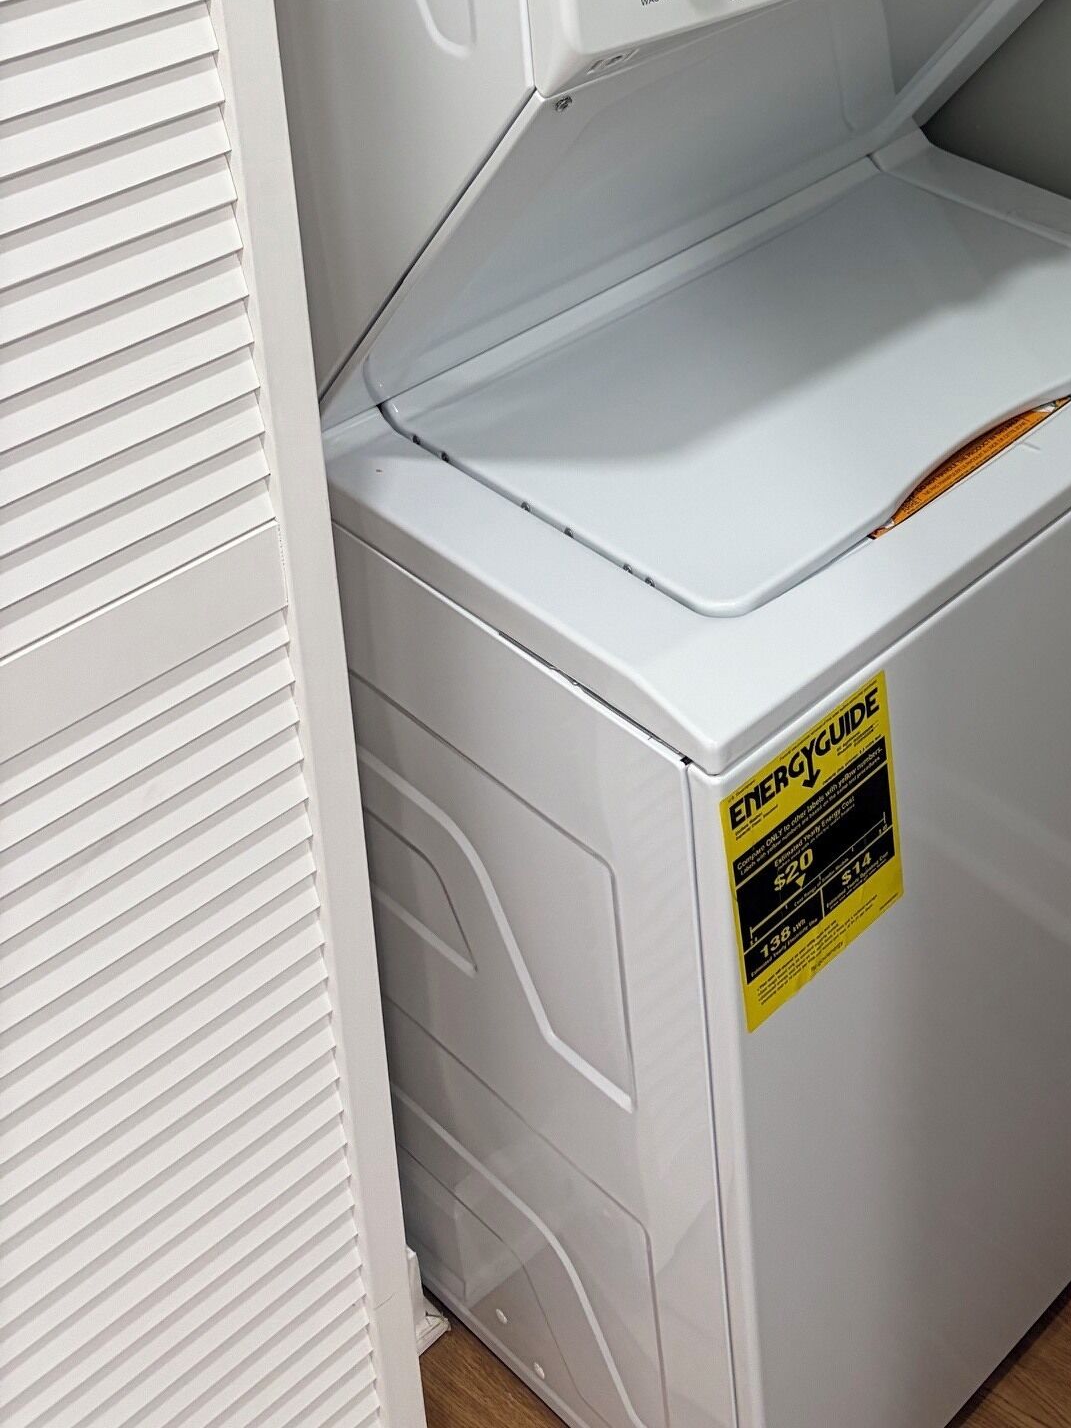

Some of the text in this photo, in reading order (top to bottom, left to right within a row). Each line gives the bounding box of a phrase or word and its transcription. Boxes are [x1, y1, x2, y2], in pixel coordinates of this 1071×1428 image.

[730, 686, 880, 831] ENERGYGUIDE
[736, 842, 765, 872] Compare
[765, 827, 782, 848] ONLY
[790, 807, 806, 826] other
[806, 792, 824, 813] labels
[824, 781, 837, 798] with
[837, 765, 856, 787] yellow
[774, 837, 802, 867] Estimated
[802, 822, 820, 843] Yearly
[821, 805, 840, 828] Energy
[841, 794, 854, 811] Cost
[773, 845, 813, 894] $20
[840, 849, 872, 888] $14
[759, 923, 791, 961] 138
